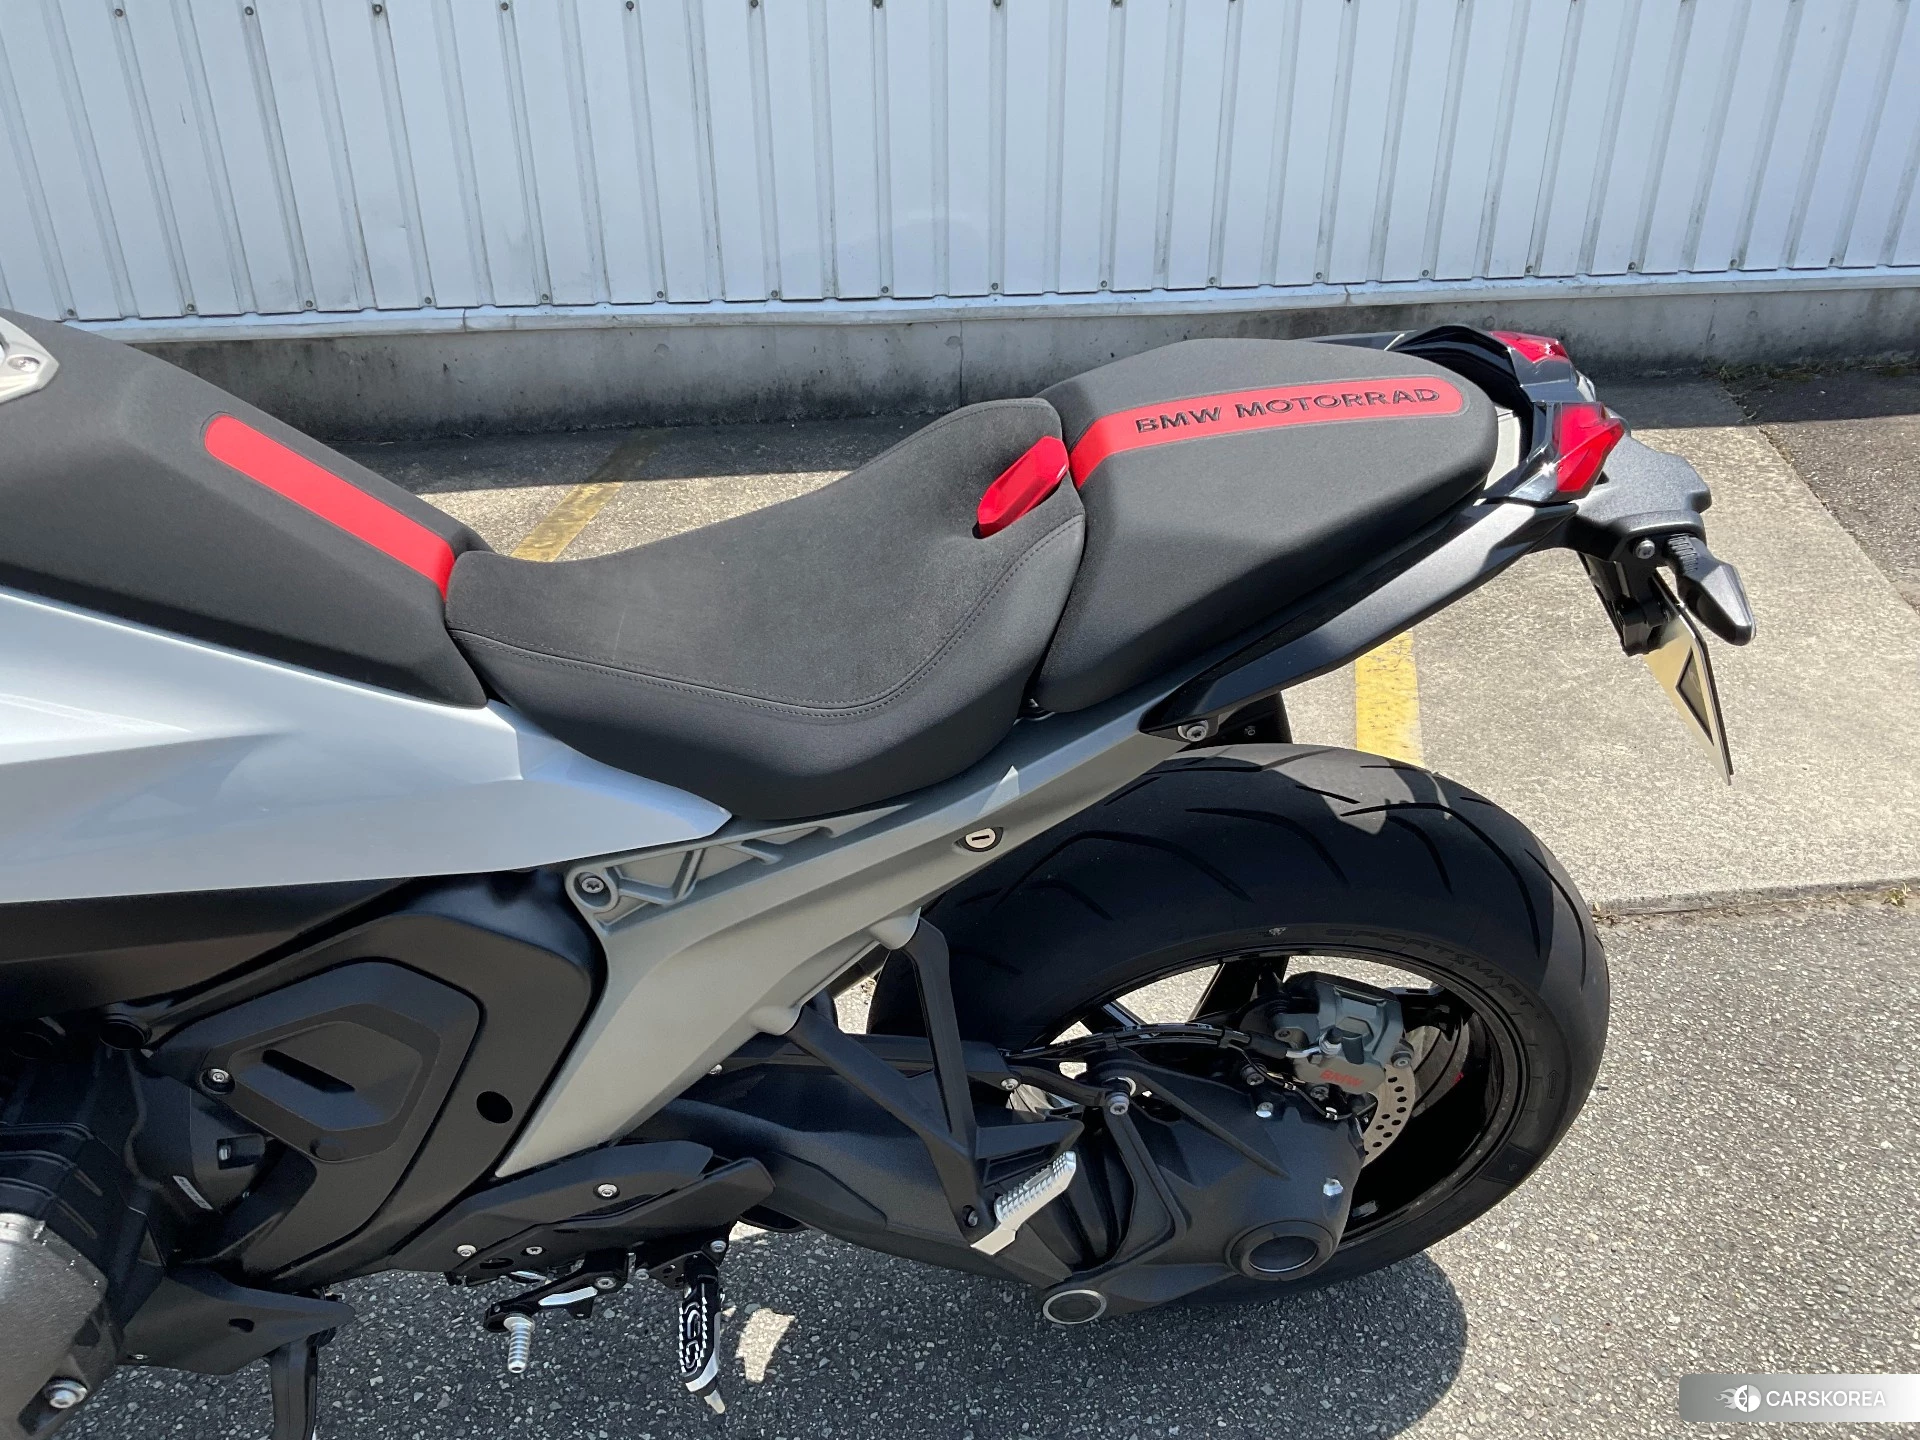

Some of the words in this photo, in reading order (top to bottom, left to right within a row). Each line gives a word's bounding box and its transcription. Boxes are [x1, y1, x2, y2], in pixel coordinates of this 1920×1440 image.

[1136, 406, 1221, 433] BMW
[1236, 388, 1440, 419] MOTORRAD
[1320, 1069, 1363, 1086] BMW
